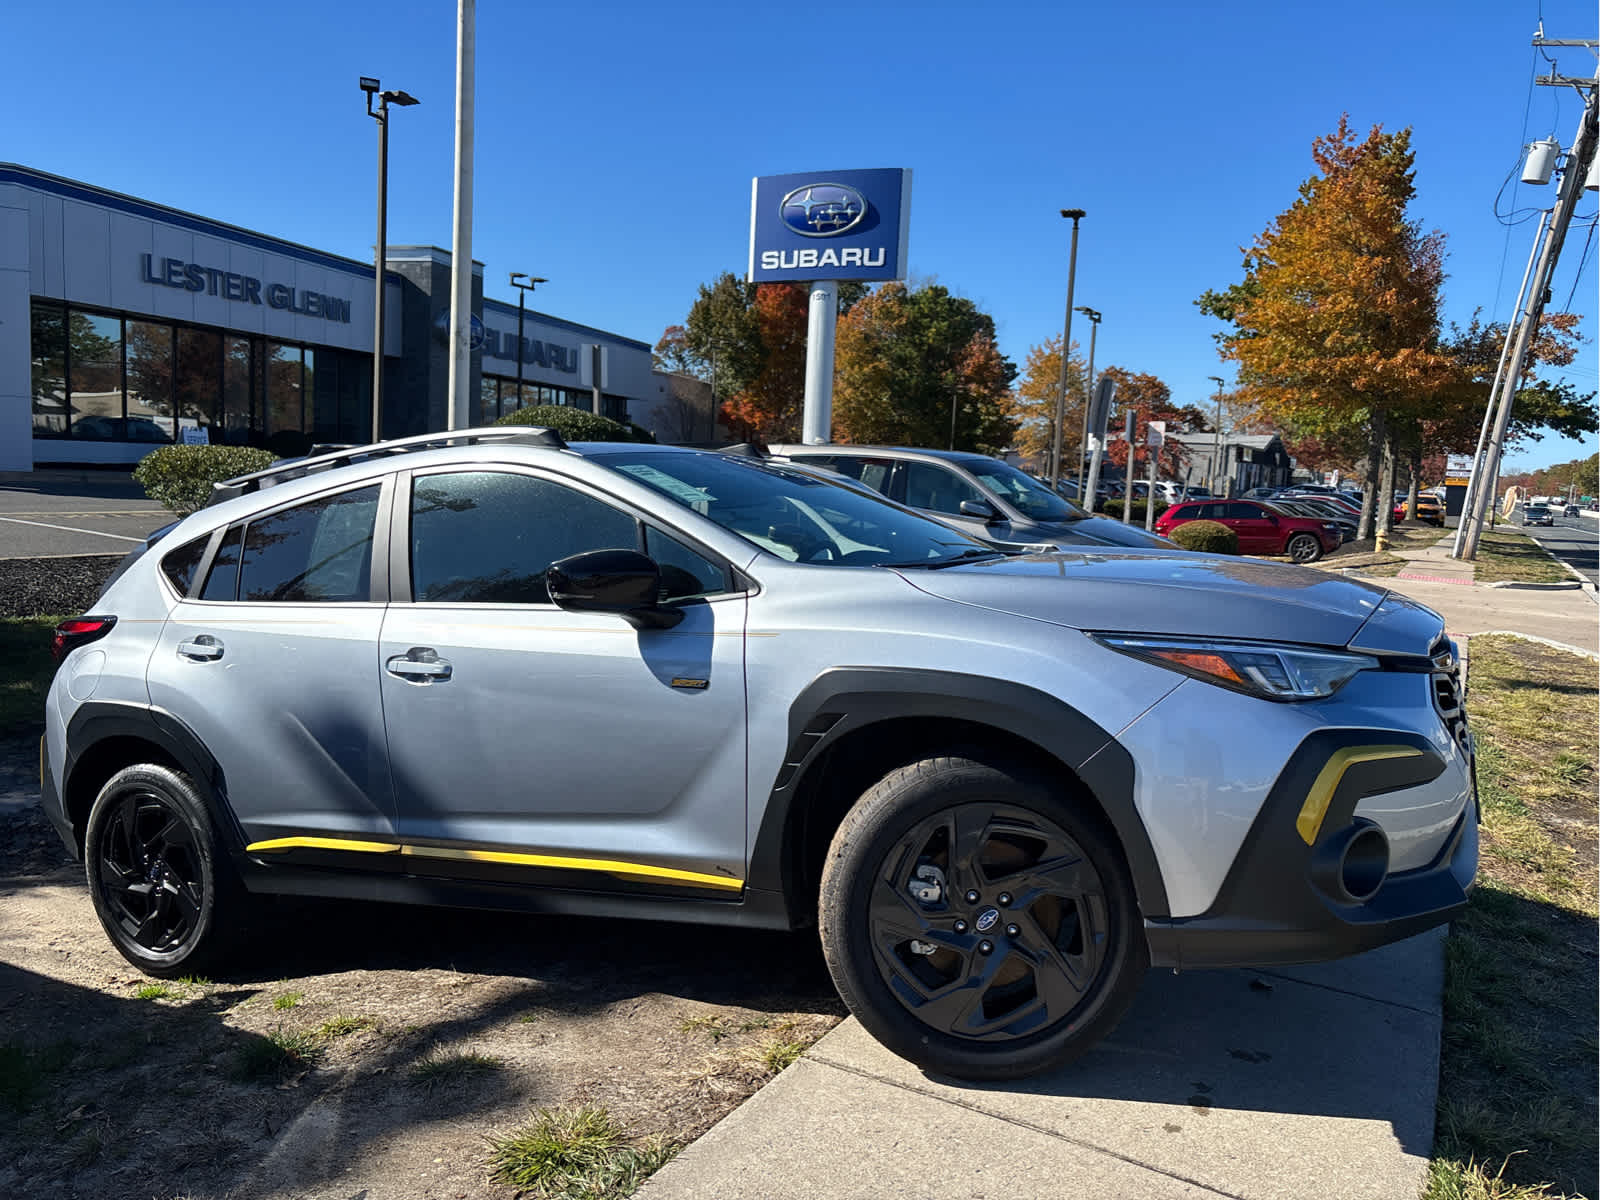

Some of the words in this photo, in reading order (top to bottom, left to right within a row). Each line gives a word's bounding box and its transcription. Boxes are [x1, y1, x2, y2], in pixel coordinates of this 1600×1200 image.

[761, 248, 885, 270] SUBARU
[141, 252, 264, 305] LESTER
[267, 282, 352, 324] GLENN
[484, 327, 578, 373] SUBARU
